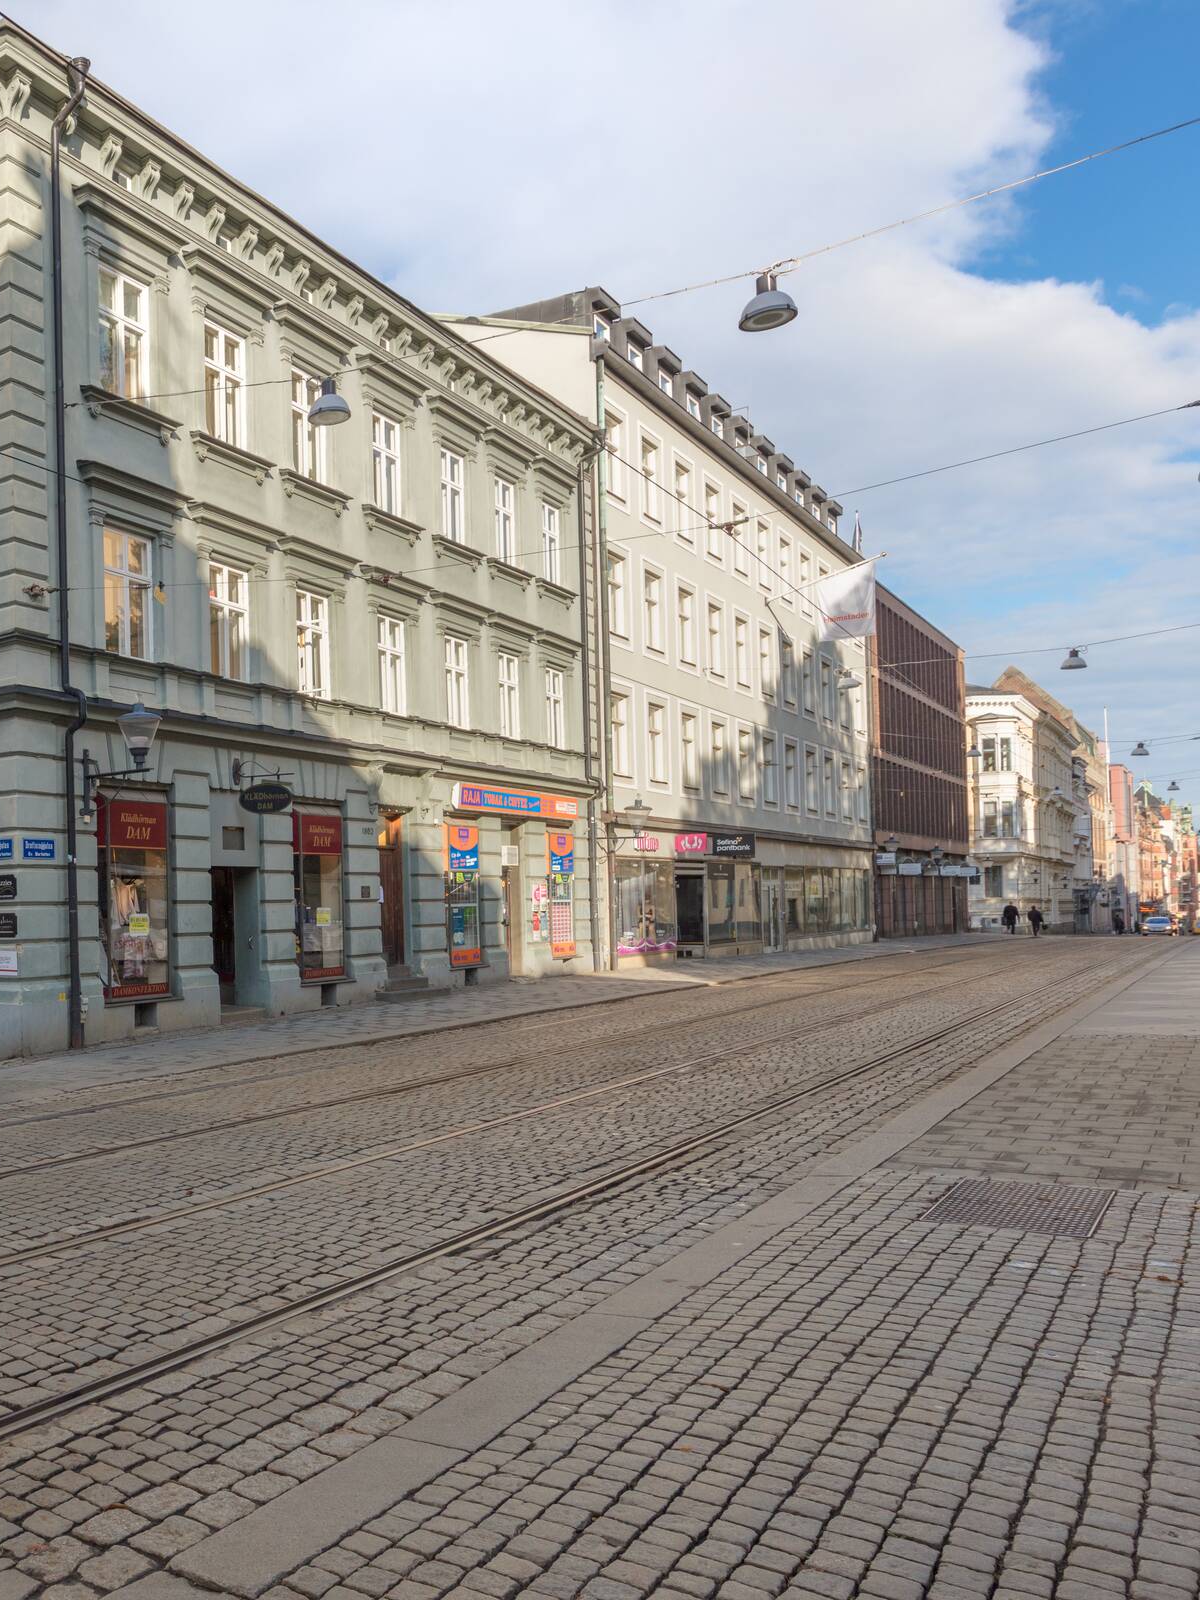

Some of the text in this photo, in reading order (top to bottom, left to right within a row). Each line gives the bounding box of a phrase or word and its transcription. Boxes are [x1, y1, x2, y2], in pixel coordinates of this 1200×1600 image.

[463, 789, 480, 804] RAJA
[127, 826, 150, 840] DAM
[313, 836, 330, 847] DAM
